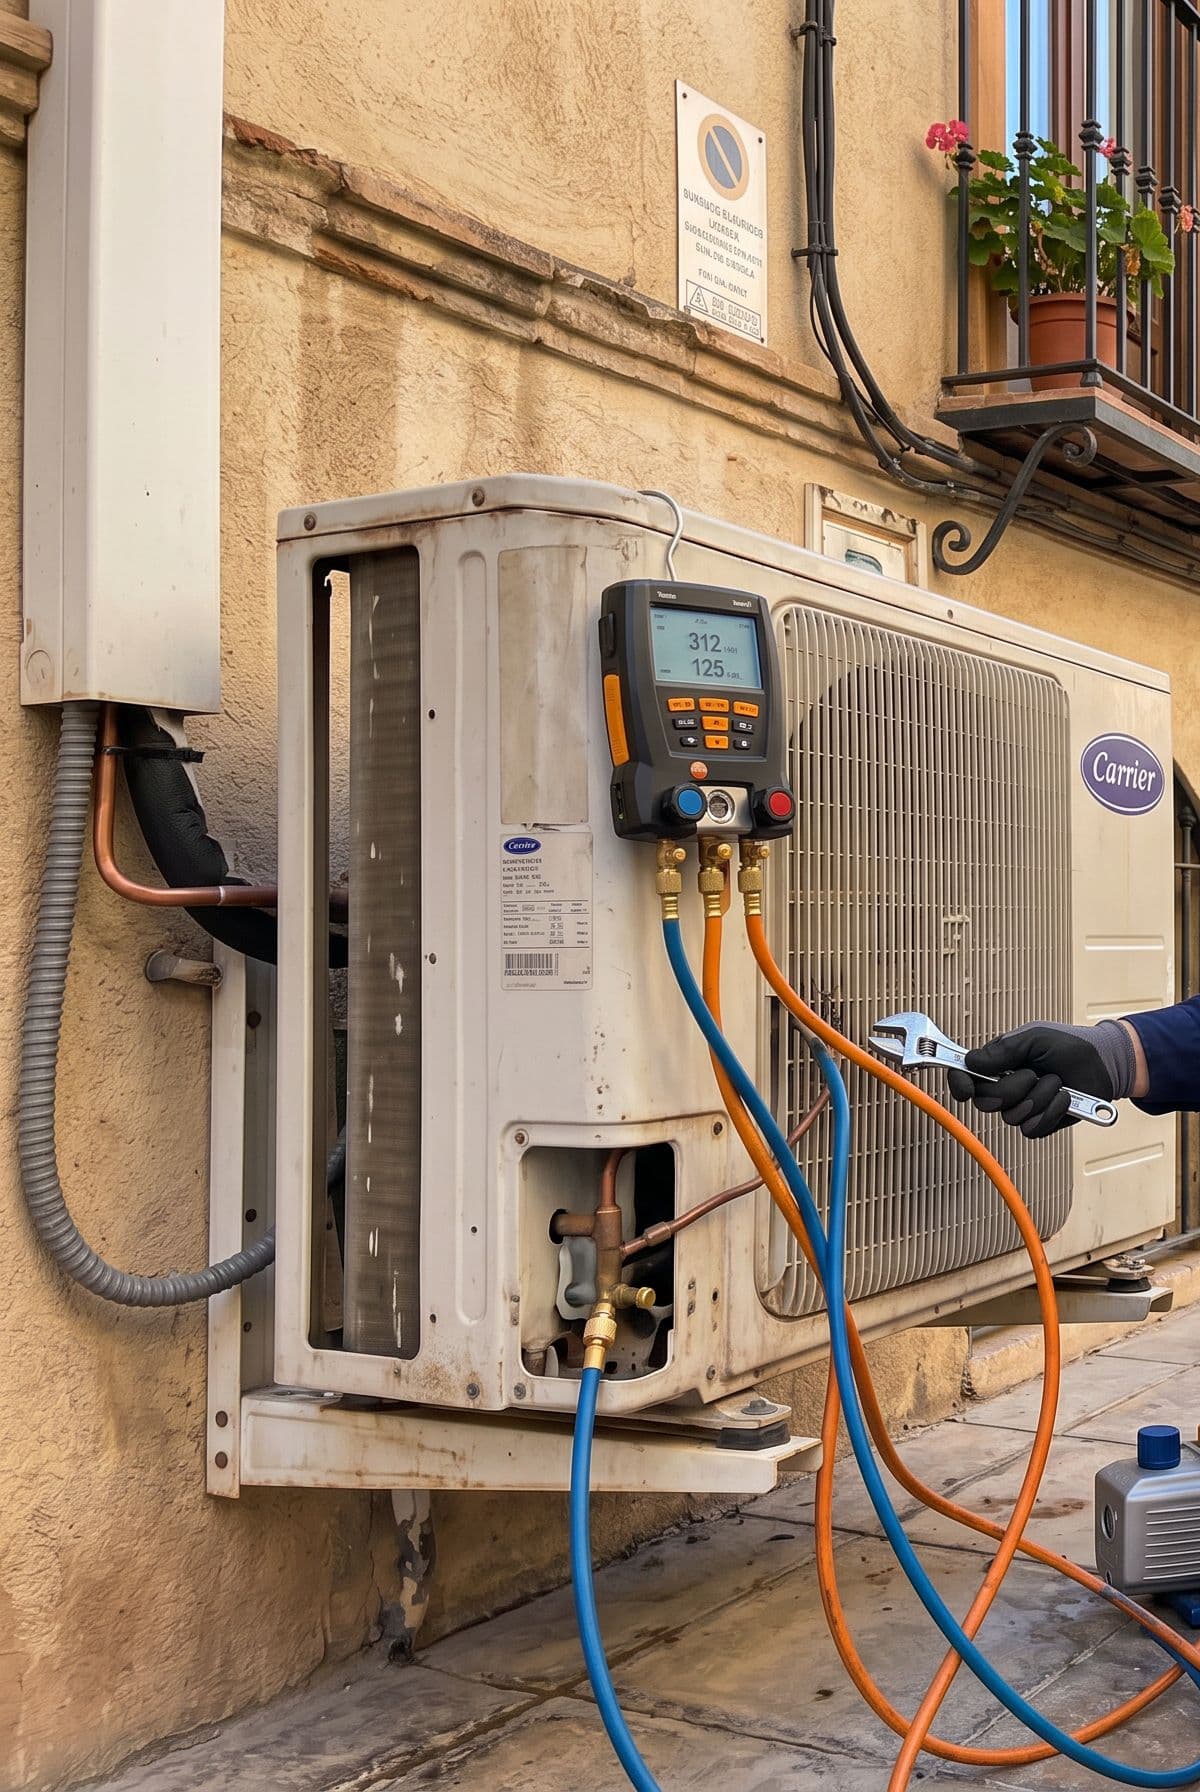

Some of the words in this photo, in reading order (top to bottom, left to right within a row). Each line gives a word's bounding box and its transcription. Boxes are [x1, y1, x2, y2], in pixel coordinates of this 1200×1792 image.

[689, 632, 721, 653] 312
[692, 658, 724, 678] 125
[1093, 751, 1156, 792] Carrier
